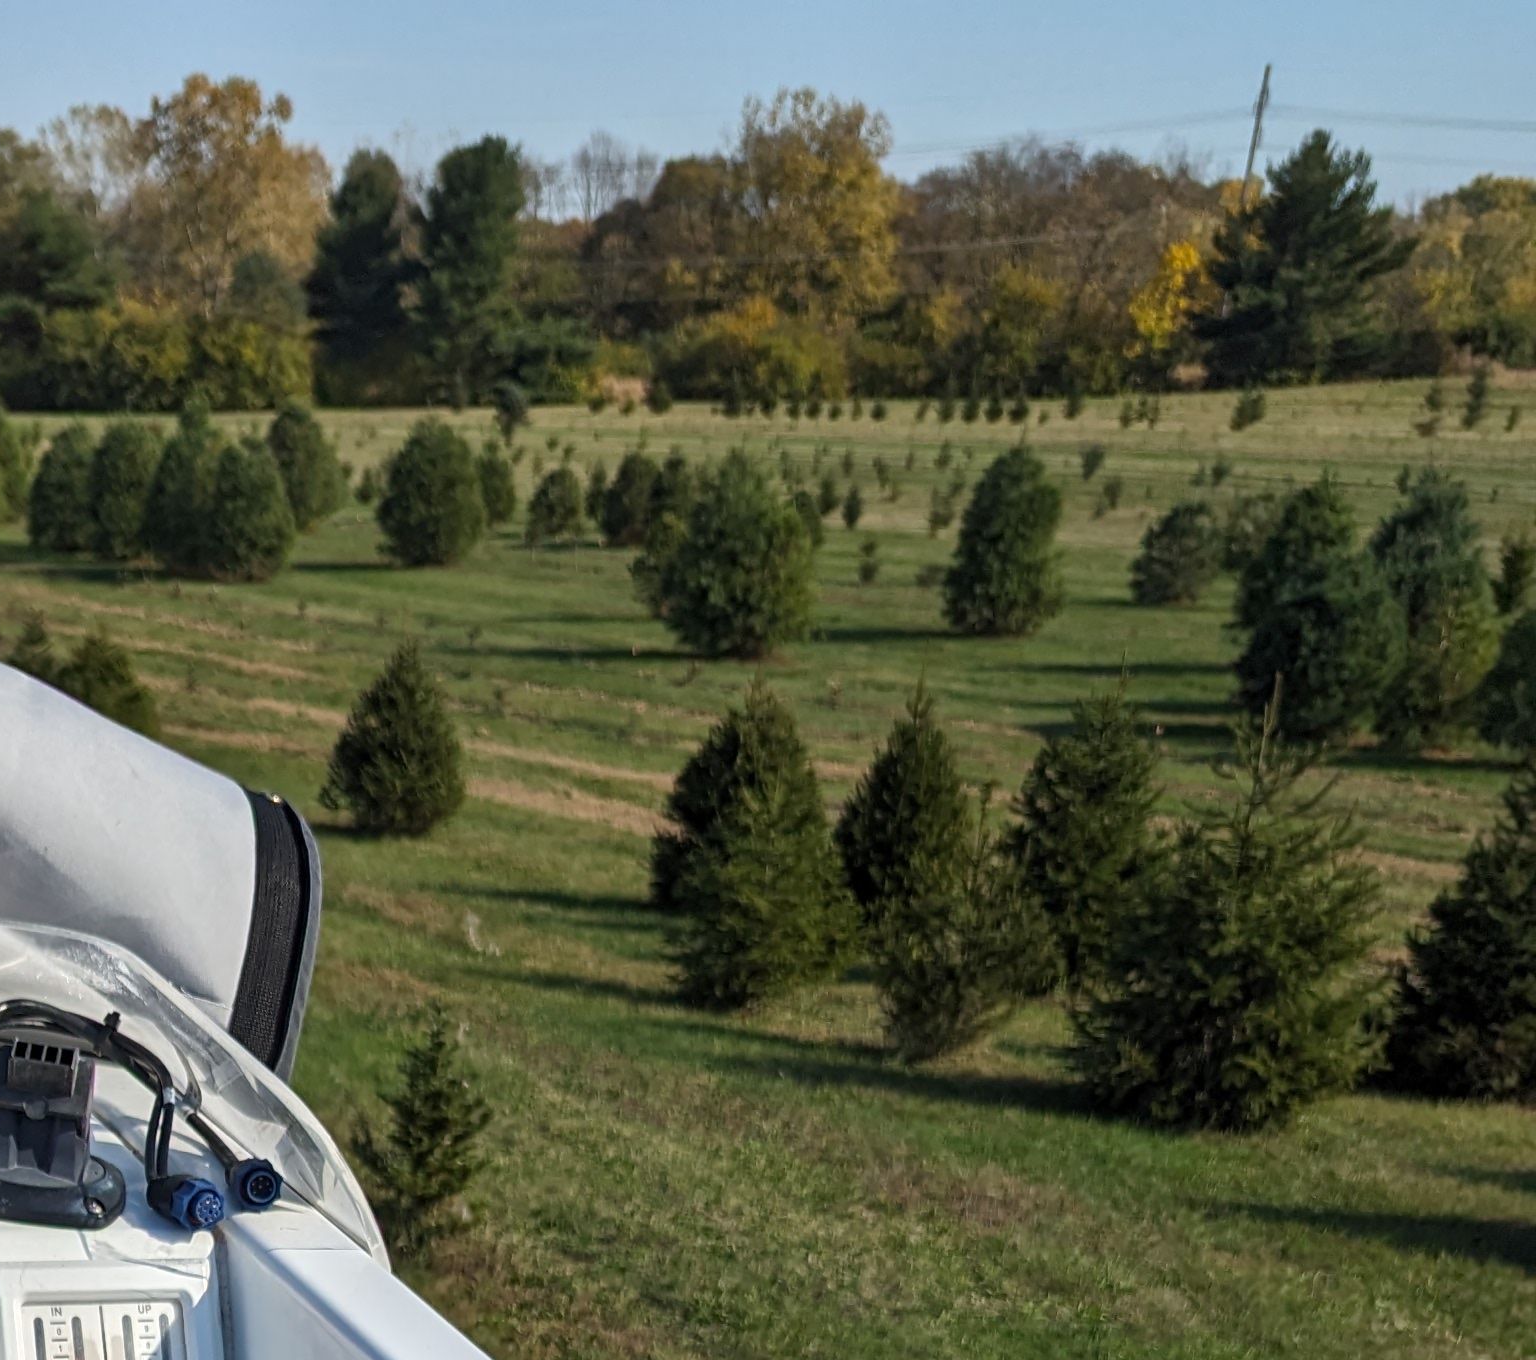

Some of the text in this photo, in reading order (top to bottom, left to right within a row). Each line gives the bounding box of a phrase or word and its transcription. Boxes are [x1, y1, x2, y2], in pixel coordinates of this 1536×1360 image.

[50, 1307, 63, 1317] IN
[137, 1304, 152, 1315] UP
[56, 1328, 62, 1337] 0
[58, 1345, 63, 1353] 1
